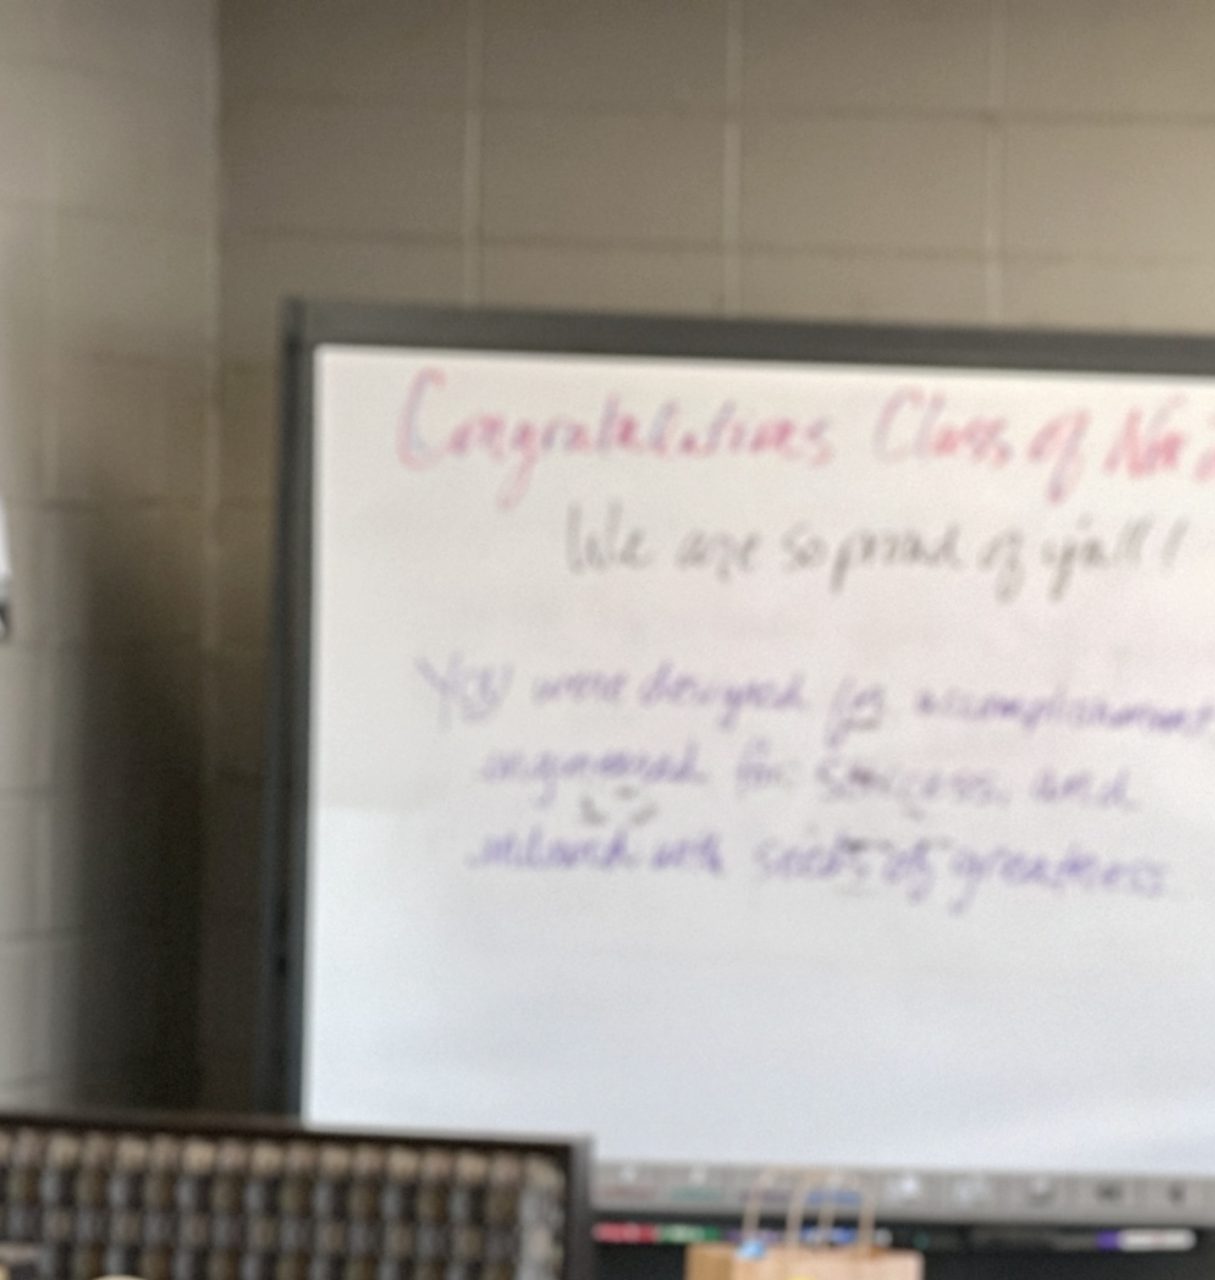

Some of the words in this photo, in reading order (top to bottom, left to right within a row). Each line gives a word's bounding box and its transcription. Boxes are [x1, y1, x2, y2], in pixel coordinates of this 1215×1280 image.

[396, 367, 834, 510] Congratulations
[872, 386, 1014, 468] Class
[1026, 408, 1091, 505] of
[565, 501, 658, 575] We
[677, 530, 762, 583] are
[780, 521, 829, 572] so
[976, 527, 1026, 604] of
